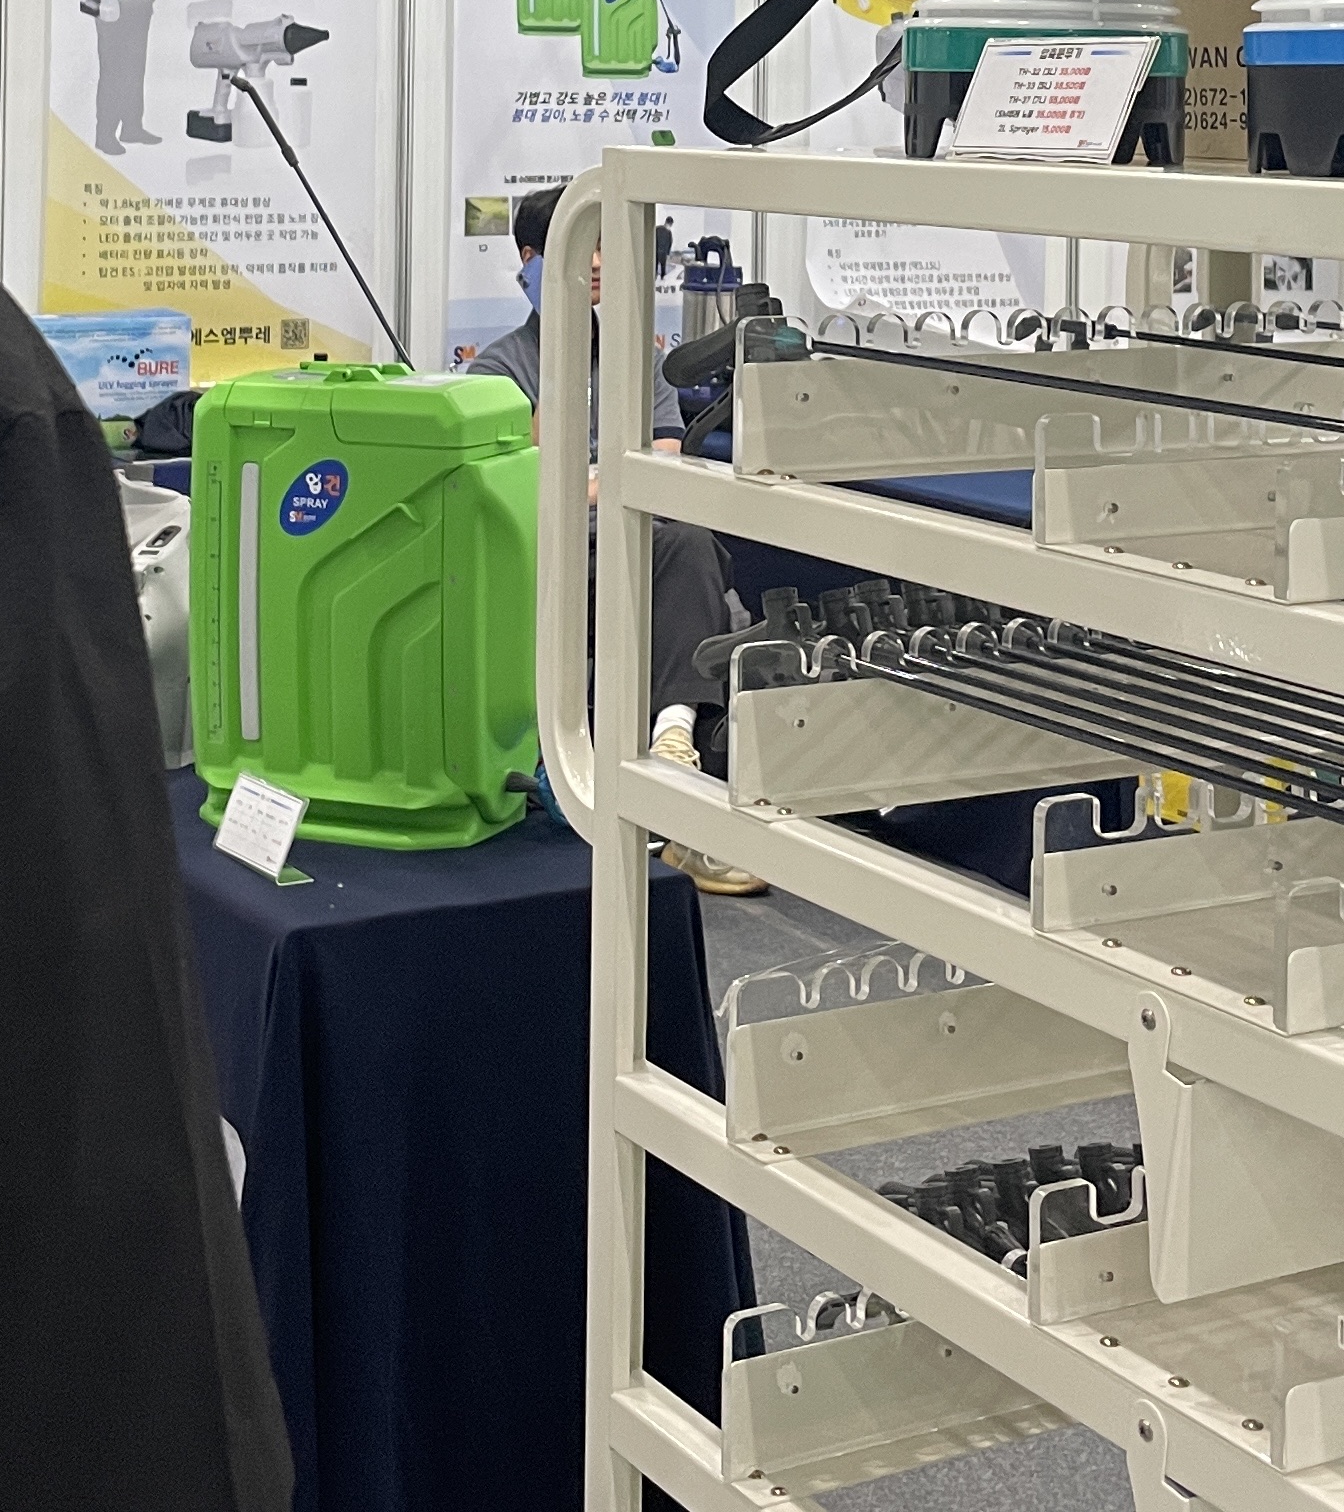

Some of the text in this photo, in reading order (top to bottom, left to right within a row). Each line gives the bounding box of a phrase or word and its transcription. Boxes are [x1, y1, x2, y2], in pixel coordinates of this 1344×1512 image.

[515, 91, 552, 106] 가볍고
[556, 91, 579, 106] 강도
[583, 91, 607, 106] 높은
[540, 108, 567, 123] 길이,
[598, 108, 610, 122] 수
[613, 108, 638, 123] 선택
[640, 108, 670, 123] 가능!
[137, 360, 179, 376] BURE
[293, 497, 328, 509] SPRAY
